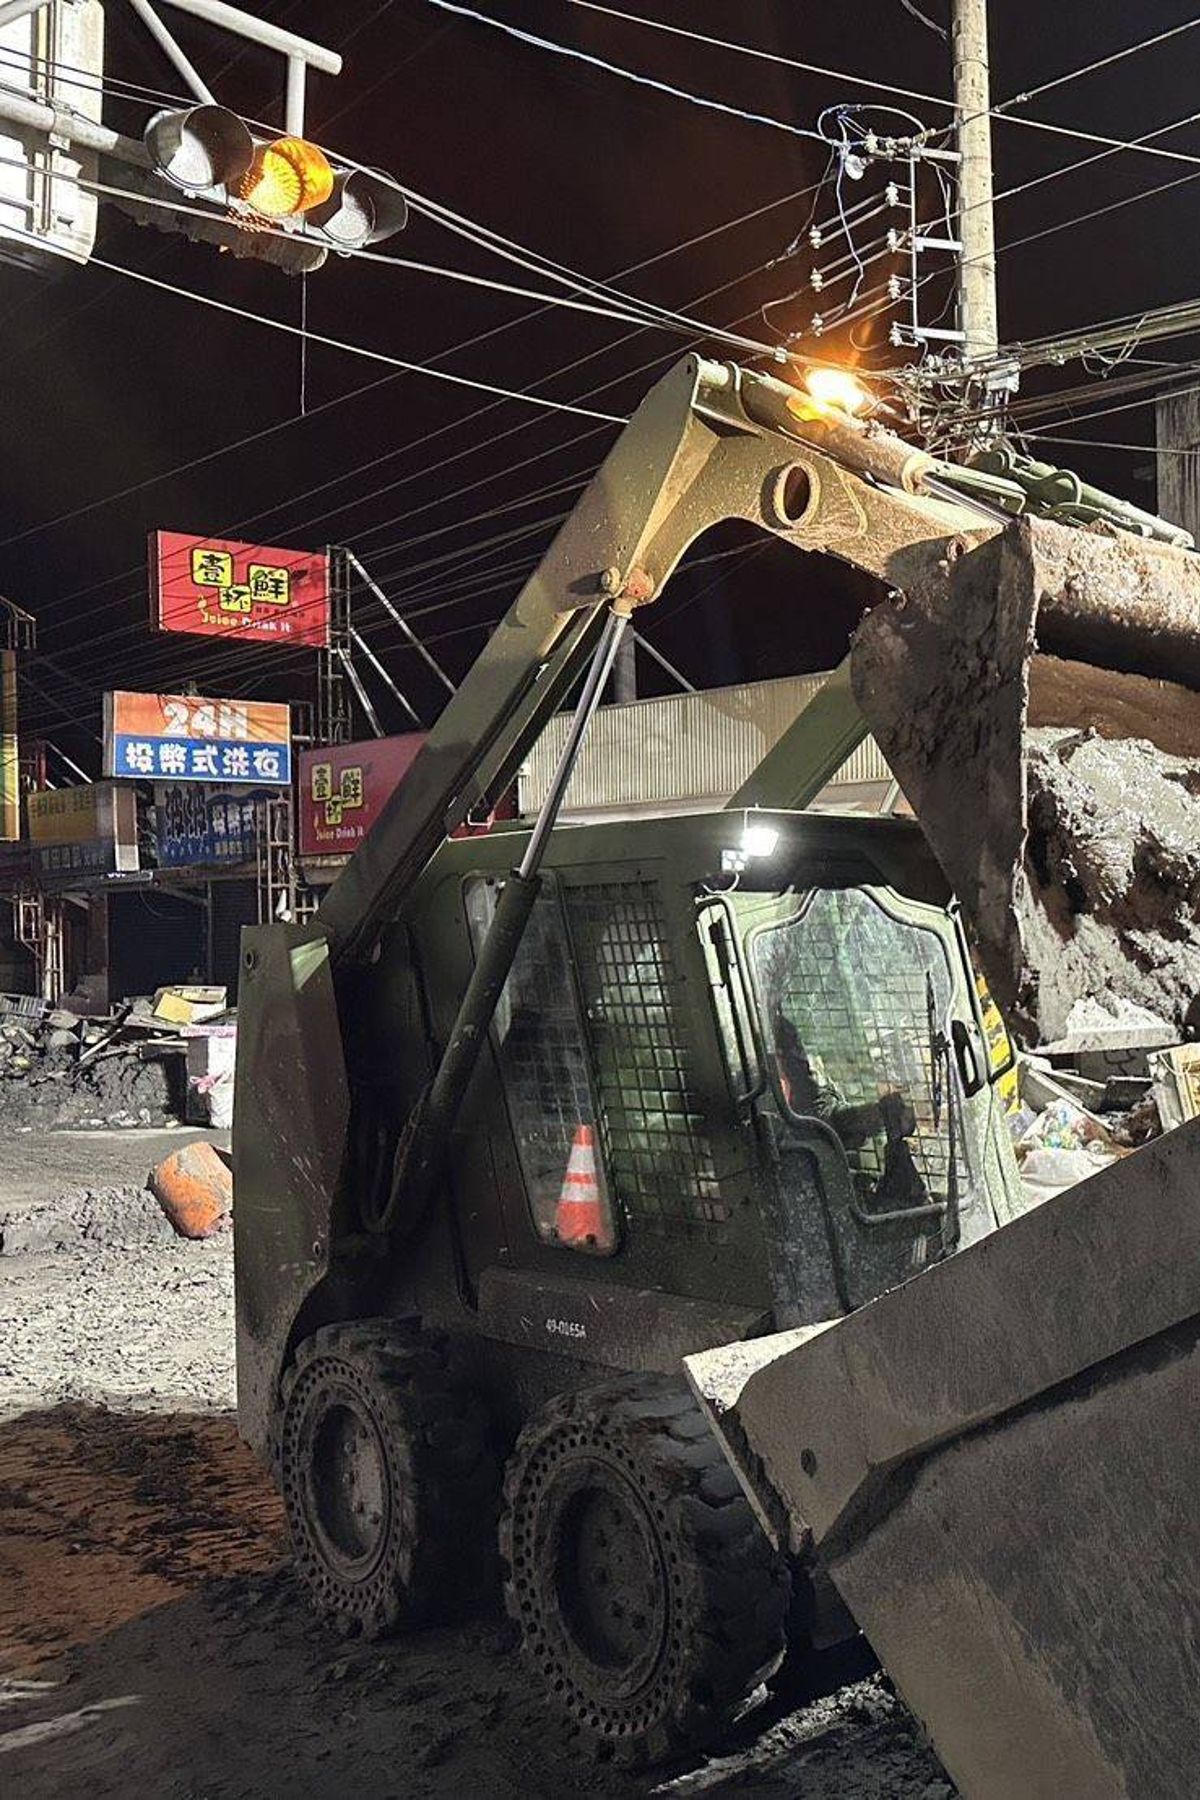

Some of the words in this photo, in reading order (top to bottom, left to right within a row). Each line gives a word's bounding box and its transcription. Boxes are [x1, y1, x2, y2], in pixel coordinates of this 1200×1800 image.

[201, 609, 238, 627] Juice
[242, 616, 278, 631] Drink
[160, 702, 248, 739] 24H
[125, 742, 280, 777] 投幣式洗衣
